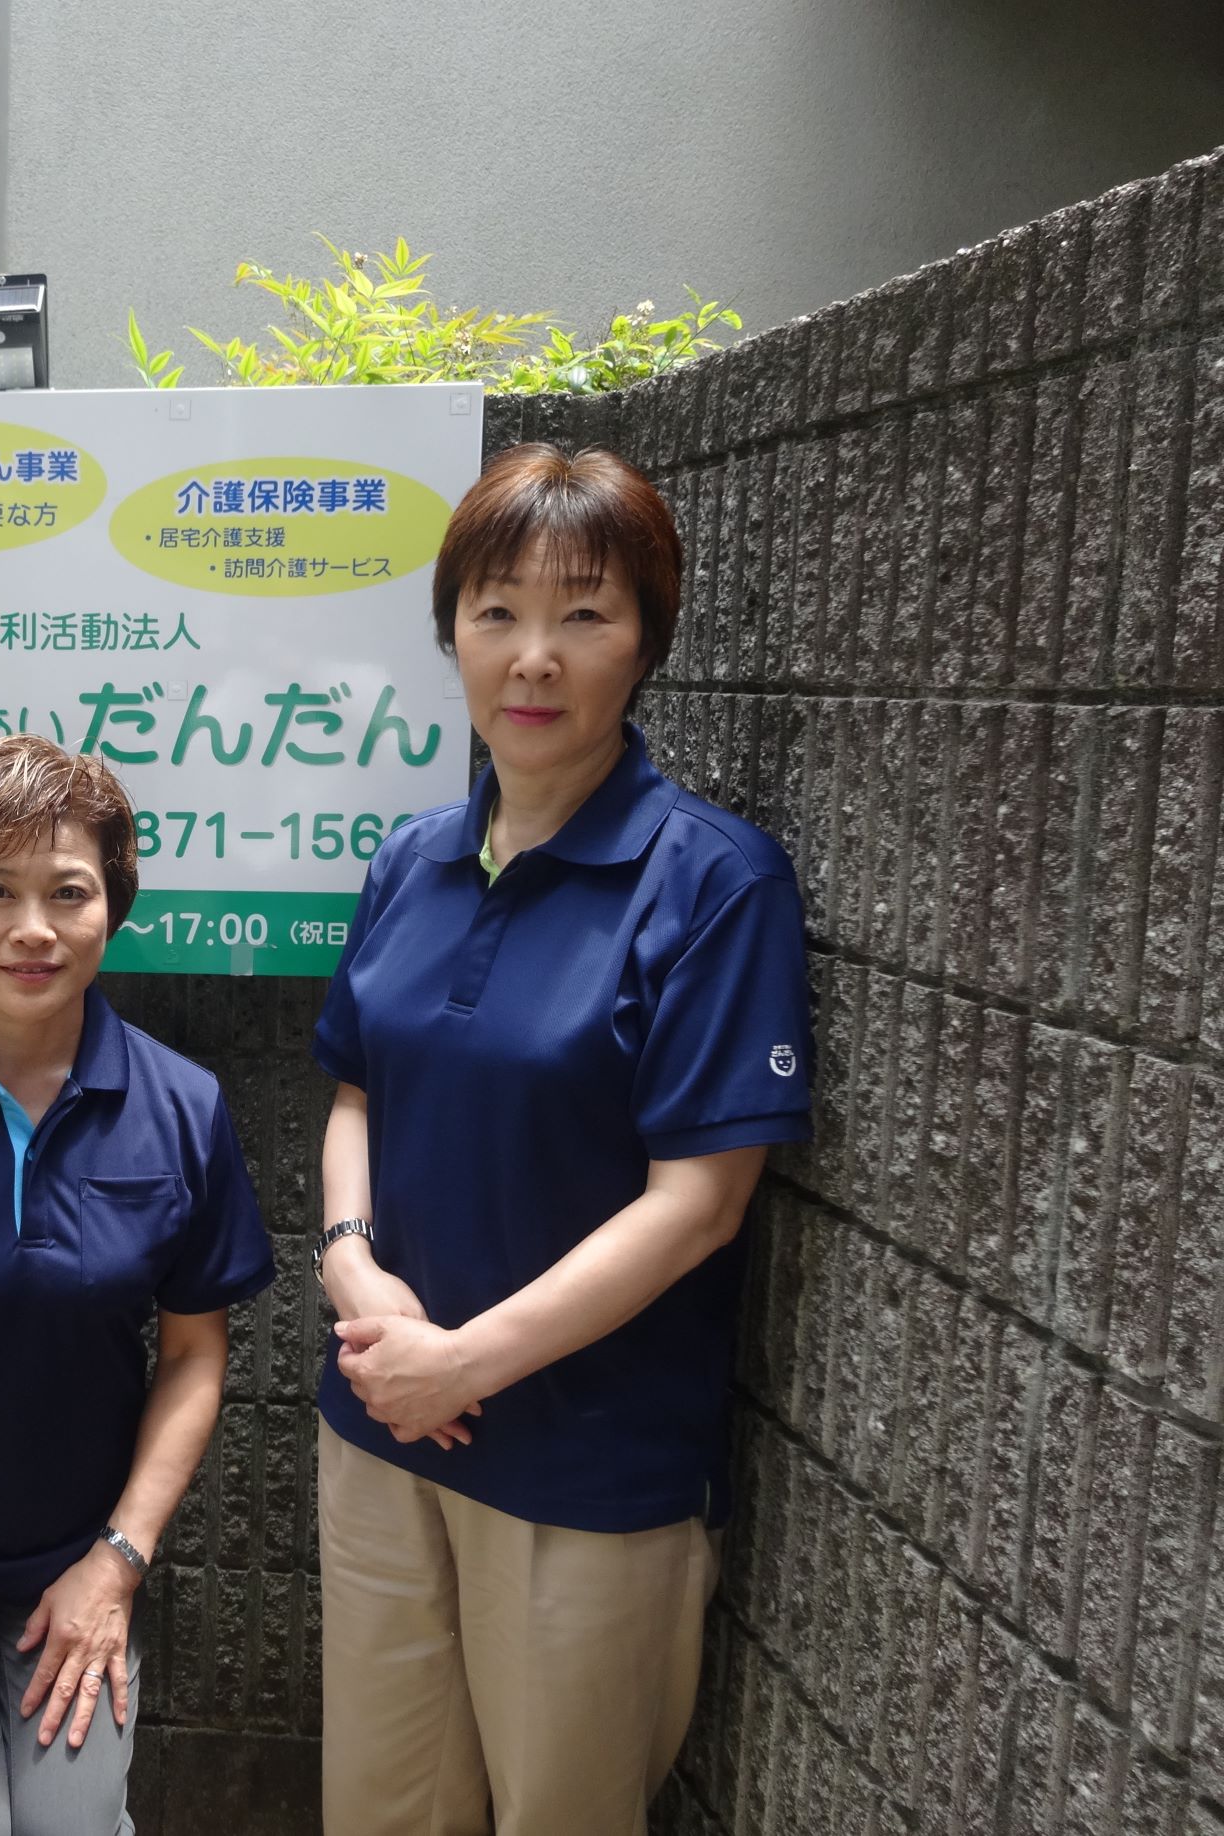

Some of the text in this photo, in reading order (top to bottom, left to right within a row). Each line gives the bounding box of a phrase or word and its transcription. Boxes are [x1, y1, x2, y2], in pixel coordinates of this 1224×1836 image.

[177, 478, 387, 514] 介護保険事業
[134, 811, 416, 861] 871-156
